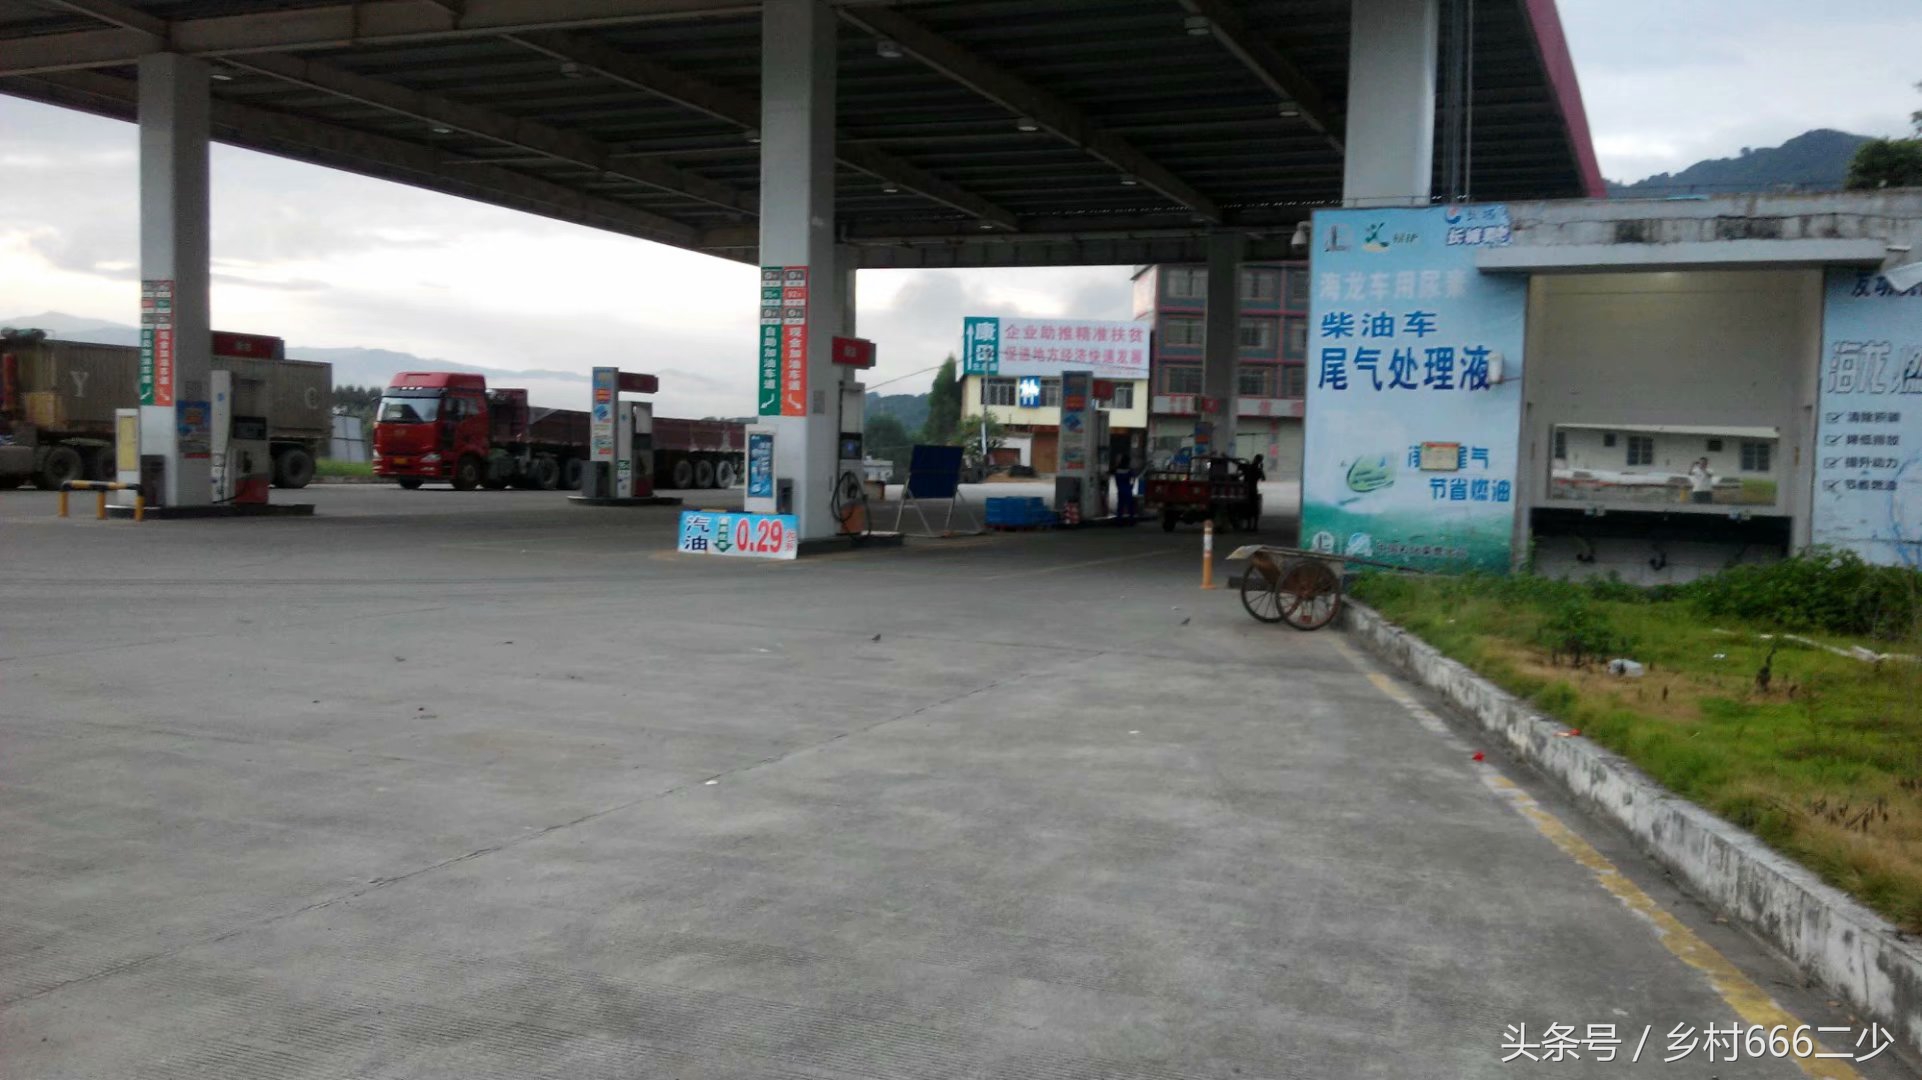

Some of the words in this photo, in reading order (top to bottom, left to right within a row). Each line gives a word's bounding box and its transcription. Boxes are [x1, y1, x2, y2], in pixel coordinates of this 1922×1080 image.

[1319, 270, 1467, 302] 海龙车用尿素
[1004, 323, 1144, 343] 企业助推精准扶贫
[1320, 310, 1438, 339] 柴油车
[1004, 345, 1144, 365] 促进地方经济快速发展
[1317, 346, 1492, 392] 尾气处理液
[70, 370, 90, 398] Y
[1429, 478, 1511, 503] 节省燃油
[684, 514, 711, 551] 汽油
[735, 518, 784, 554] 0.29
